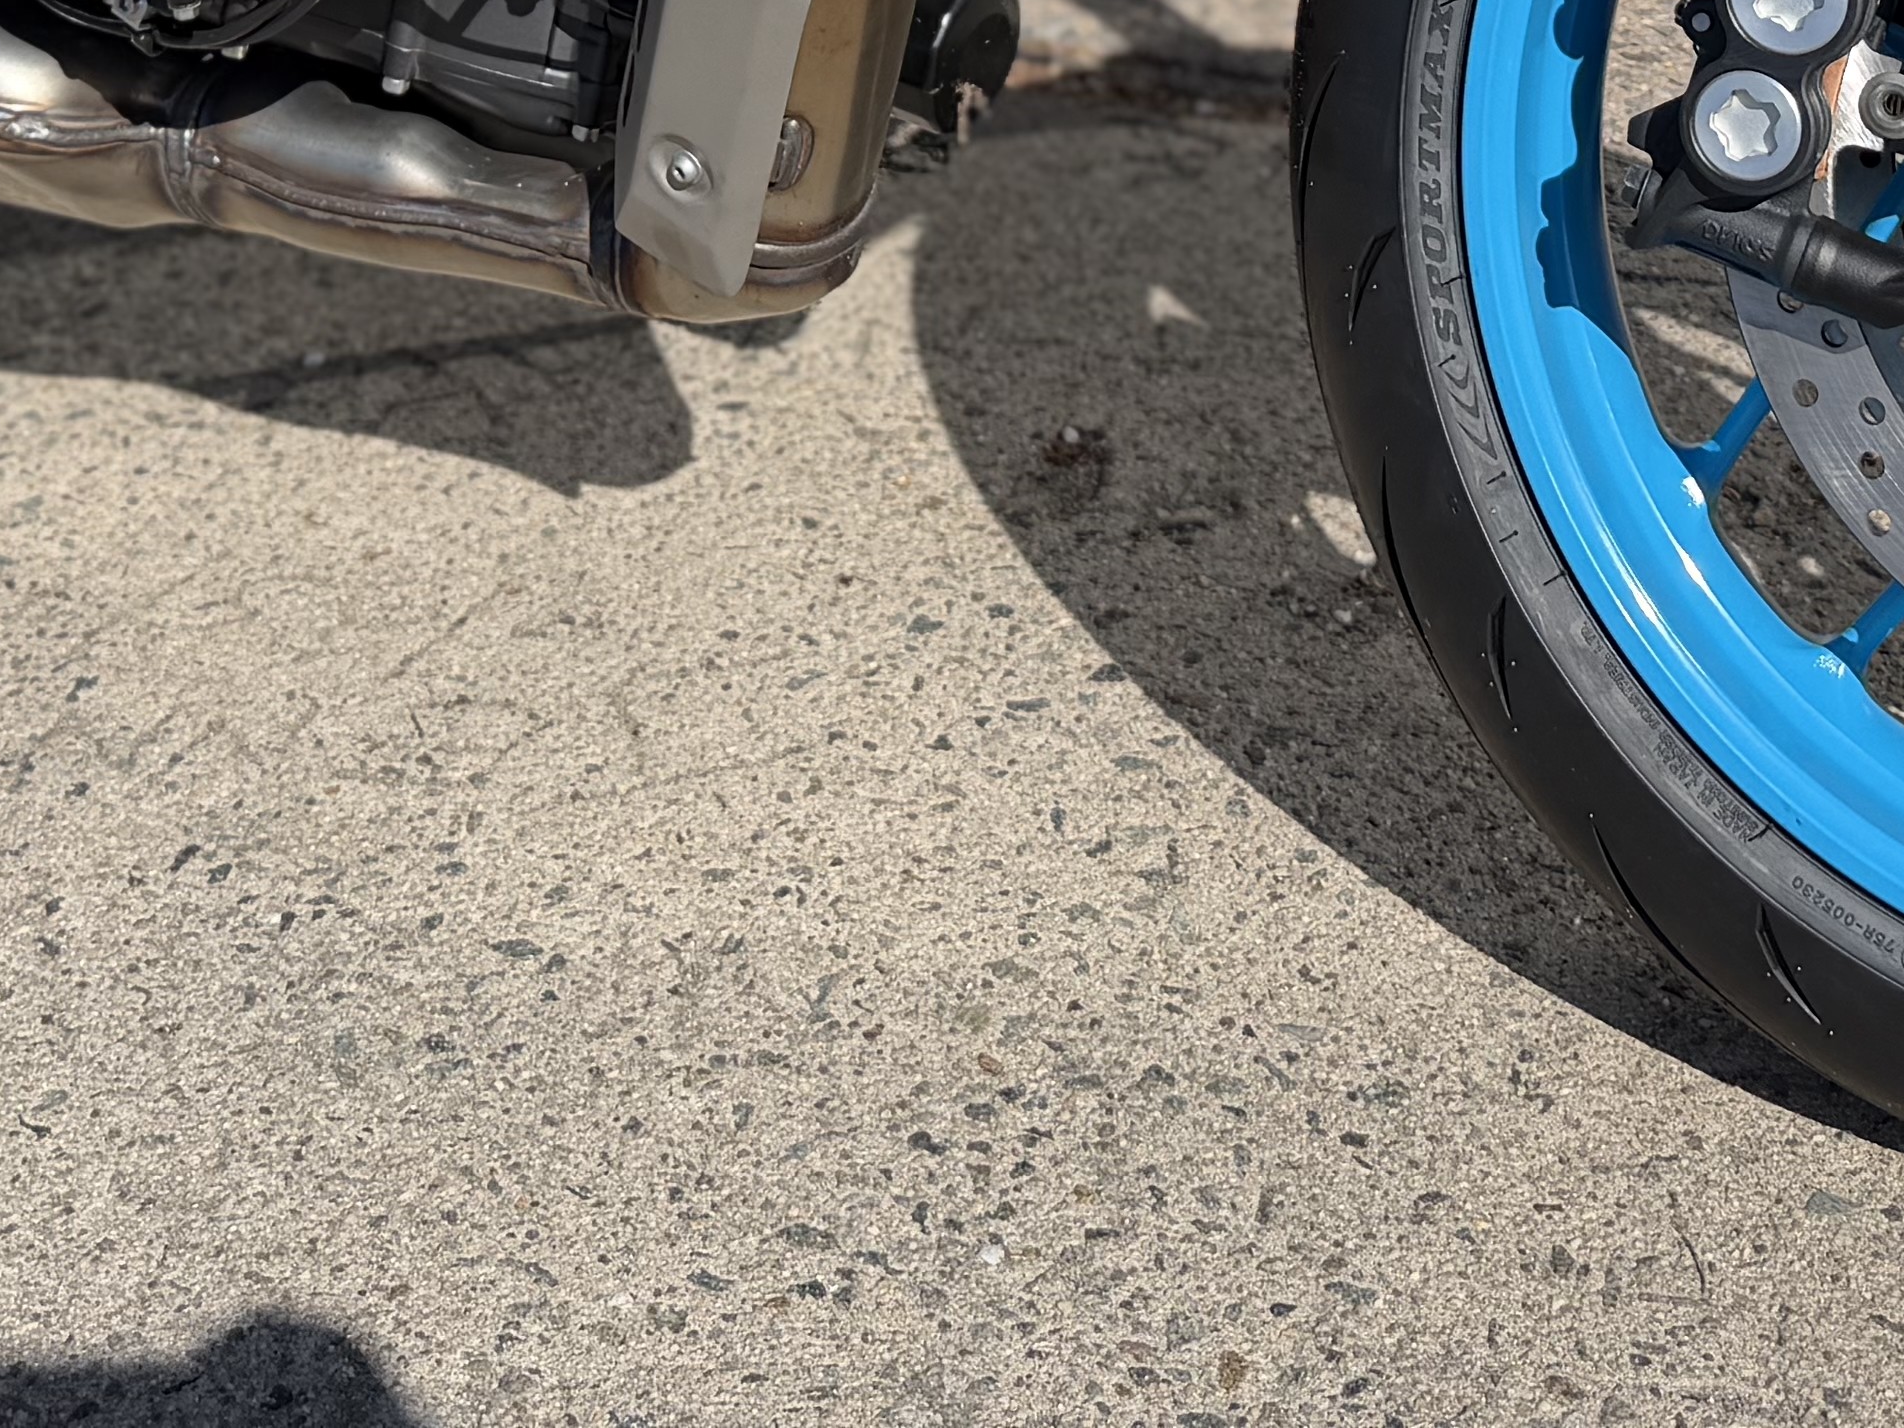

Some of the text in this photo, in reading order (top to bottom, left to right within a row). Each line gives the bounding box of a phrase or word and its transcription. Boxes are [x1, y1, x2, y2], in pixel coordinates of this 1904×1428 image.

[1652, 742, 1754, 844] MADE IN JAPAN
